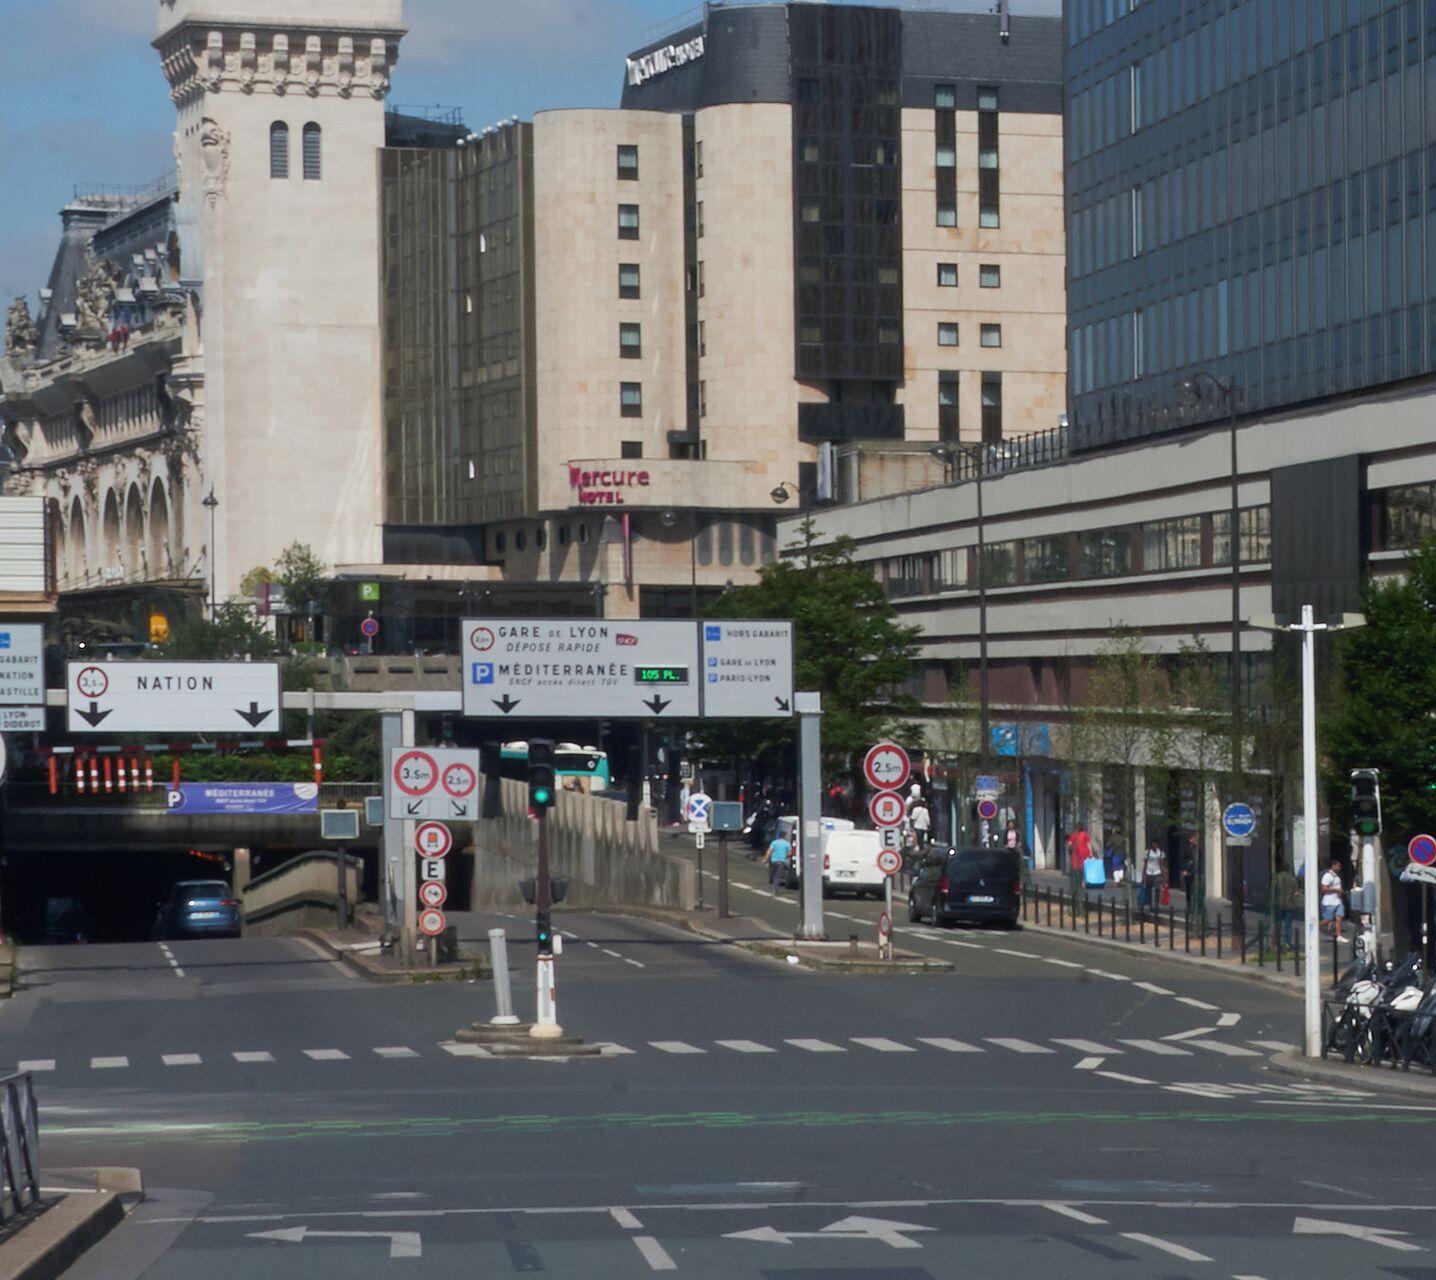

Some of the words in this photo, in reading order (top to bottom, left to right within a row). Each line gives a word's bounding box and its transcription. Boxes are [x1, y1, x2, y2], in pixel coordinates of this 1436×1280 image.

[567, 464, 650, 489] Mercure
[578, 490, 624, 504] HOTEL
[498, 626, 541, 638] GARE
[548, 629, 561, 638] DE
[569, 627, 609, 638] LYON
[726, 629, 750, 638] HORS
[752, 629, 789, 638] GABARIT
[506, 640, 552, 653] DÉPOSE
[557, 642, 601, 653] RAPIDE
[498, 662, 629, 677] MÉDITERRANÉE
[720, 659, 743, 667] GARE
[754, 659, 777, 667] LYON
[641, 670, 660, 680] 105
[137, 676, 213, 690] NATION
[601, 678, 619, 686] TGV
[4, 720, 41, 729] DIDEROT
[168, 790, 181, 808] P
[883, 830, 895, 847] E
[426, 861, 439, 878] E
